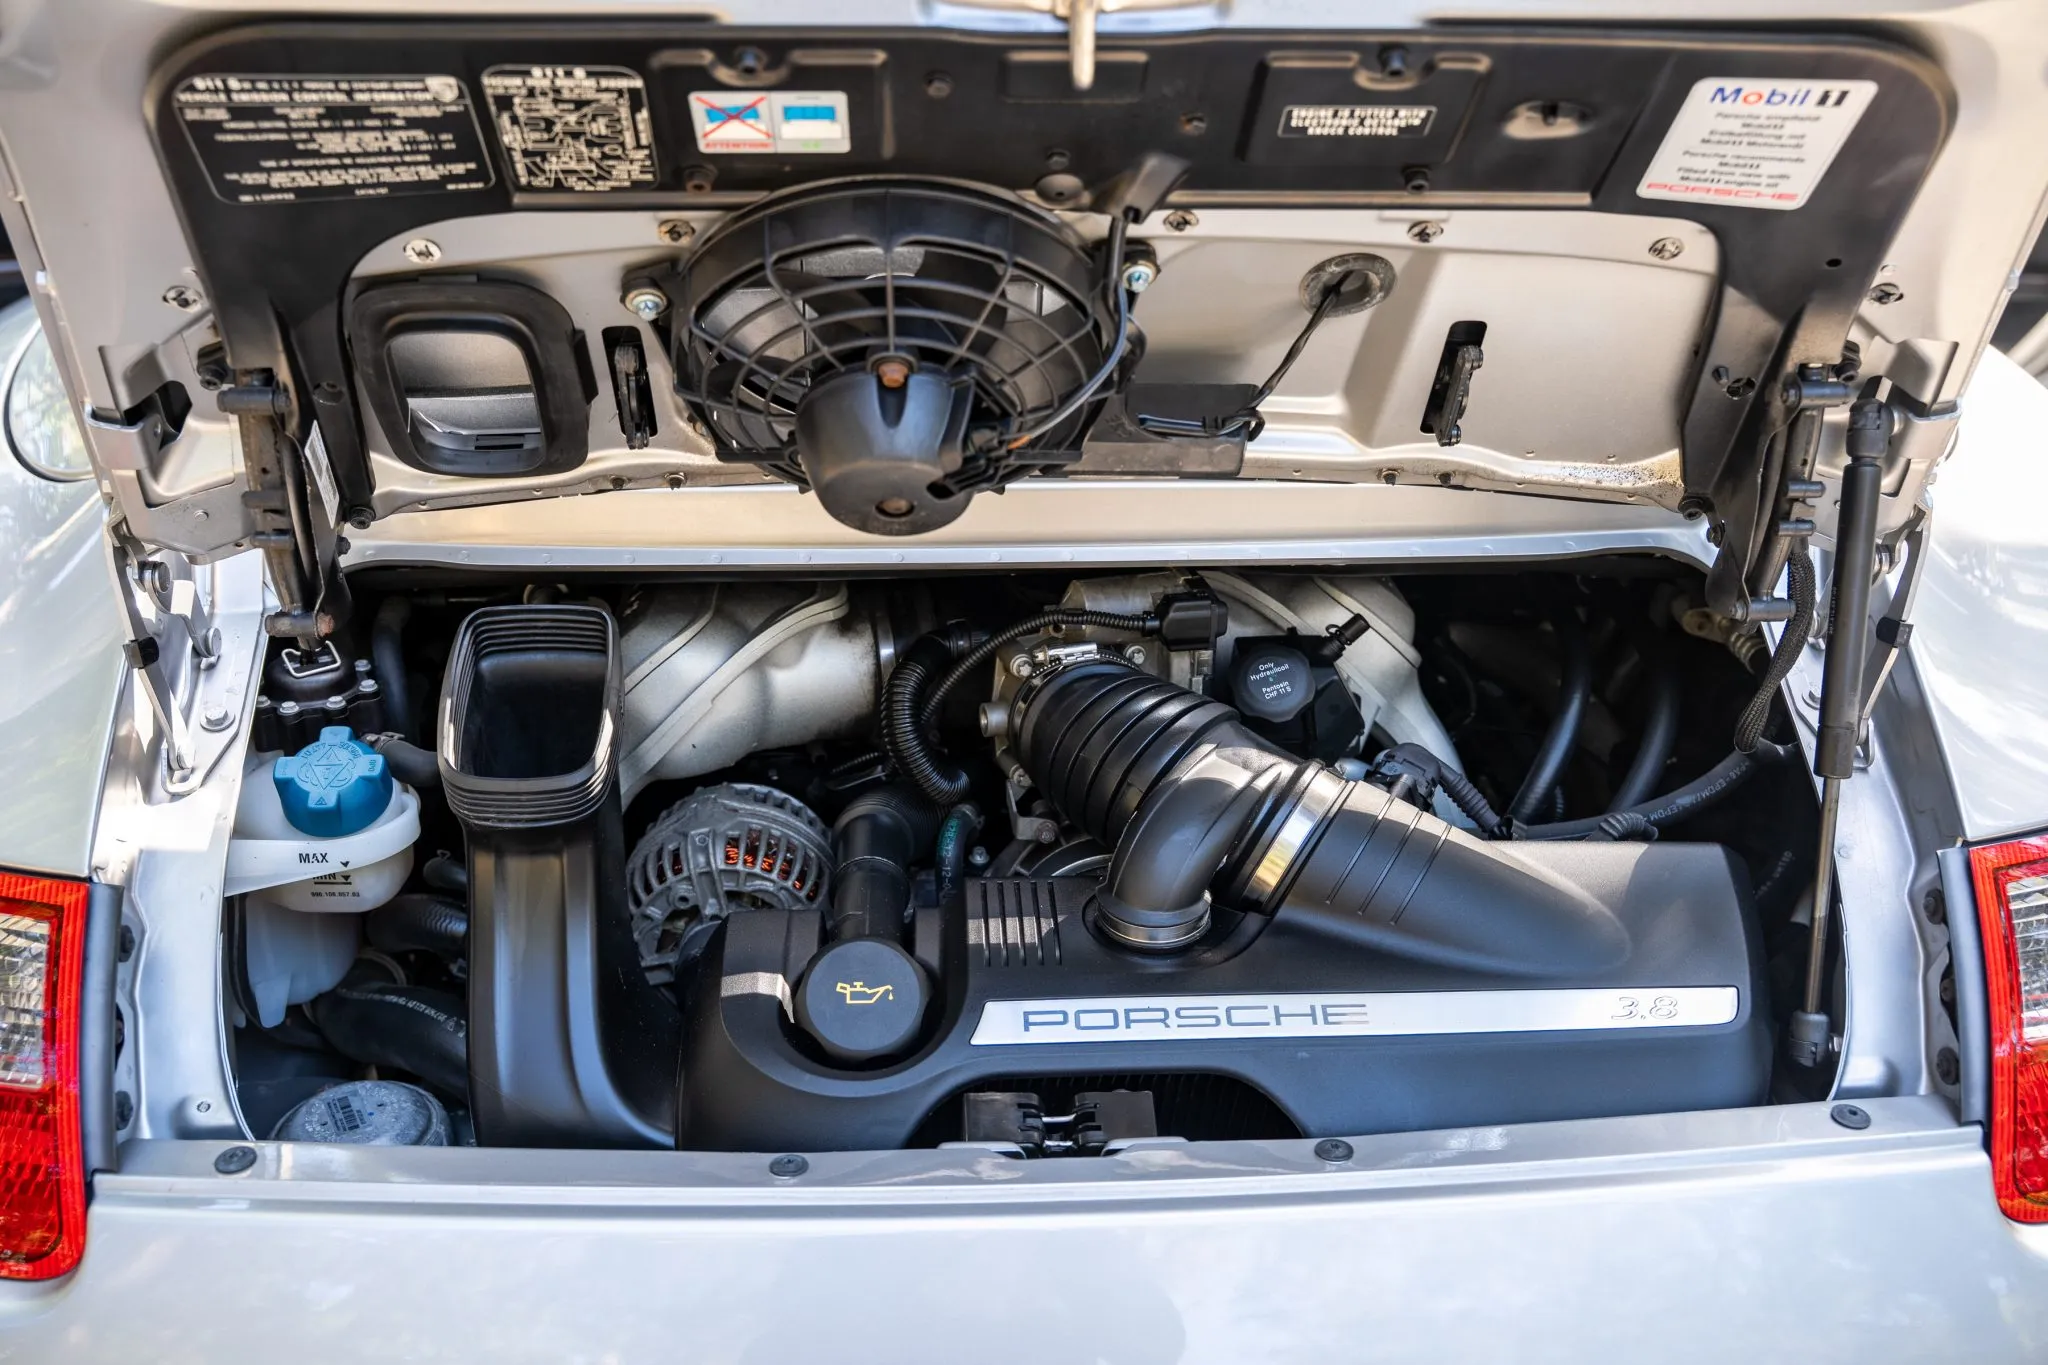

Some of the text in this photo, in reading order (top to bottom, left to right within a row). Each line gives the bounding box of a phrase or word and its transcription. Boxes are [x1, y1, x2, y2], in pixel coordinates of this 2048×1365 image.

[1709, 87, 1811, 106] Mobil
[1646, 183, 1800, 201] PORSCHE
[1258, 662, 1274, 671] Only
[1262, 682, 1288, 693] Pentosin
[1264, 692, 1278, 700] CHF
[299, 852, 329, 864] MAX
[1023, 995, 1679, 1032] PORSCHE 3.8
